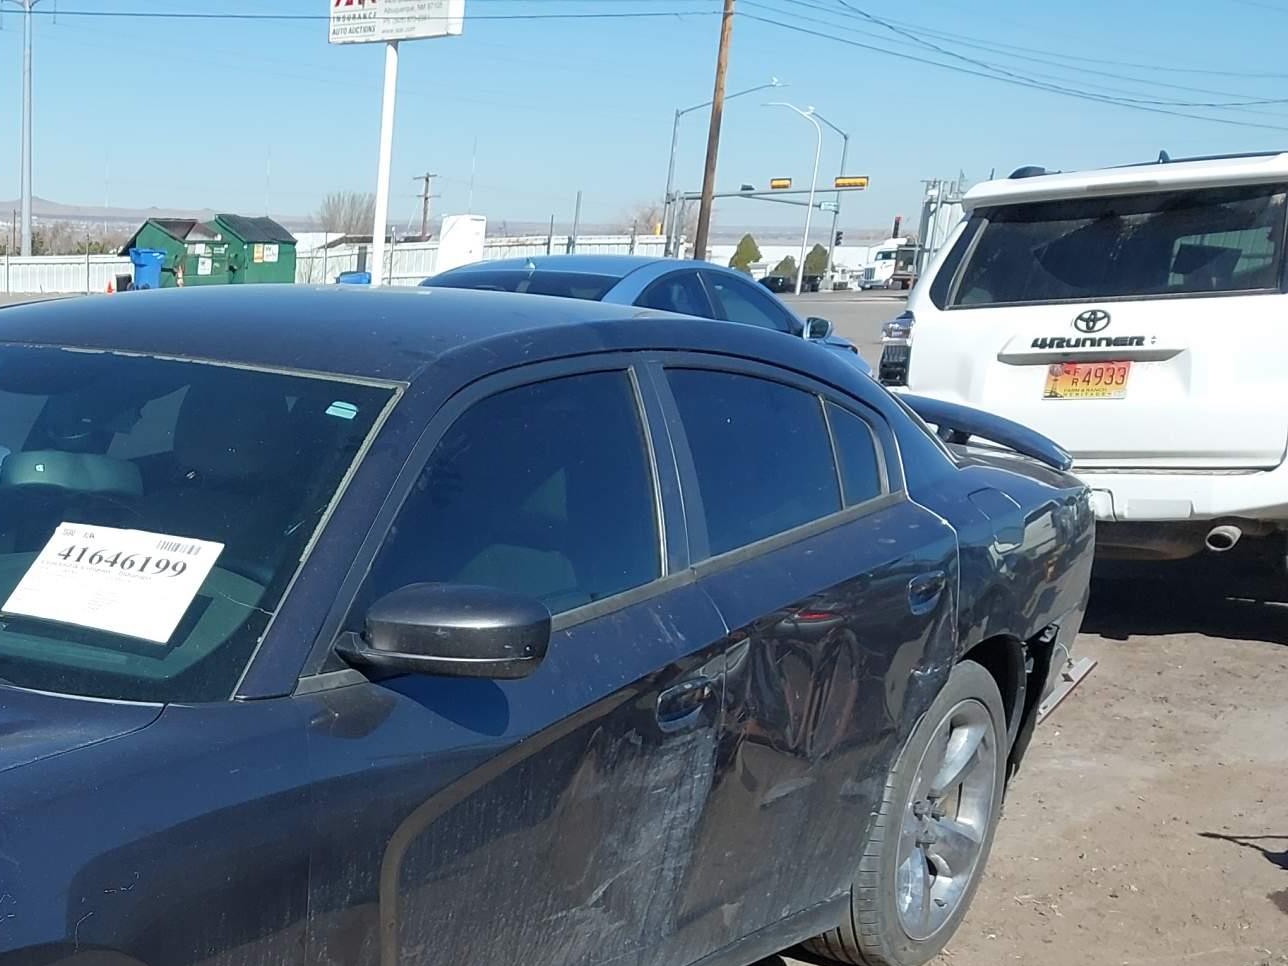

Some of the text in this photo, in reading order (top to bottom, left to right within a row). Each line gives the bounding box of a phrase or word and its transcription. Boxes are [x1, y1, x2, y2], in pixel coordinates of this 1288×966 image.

[332, 25, 376, 36] AUTO AUCTIONS
[1031, 335, 1146, 349] 4RUNNER
[1082, 366, 1127, 386] 4933
[57, 544, 188, 578] 41646199
